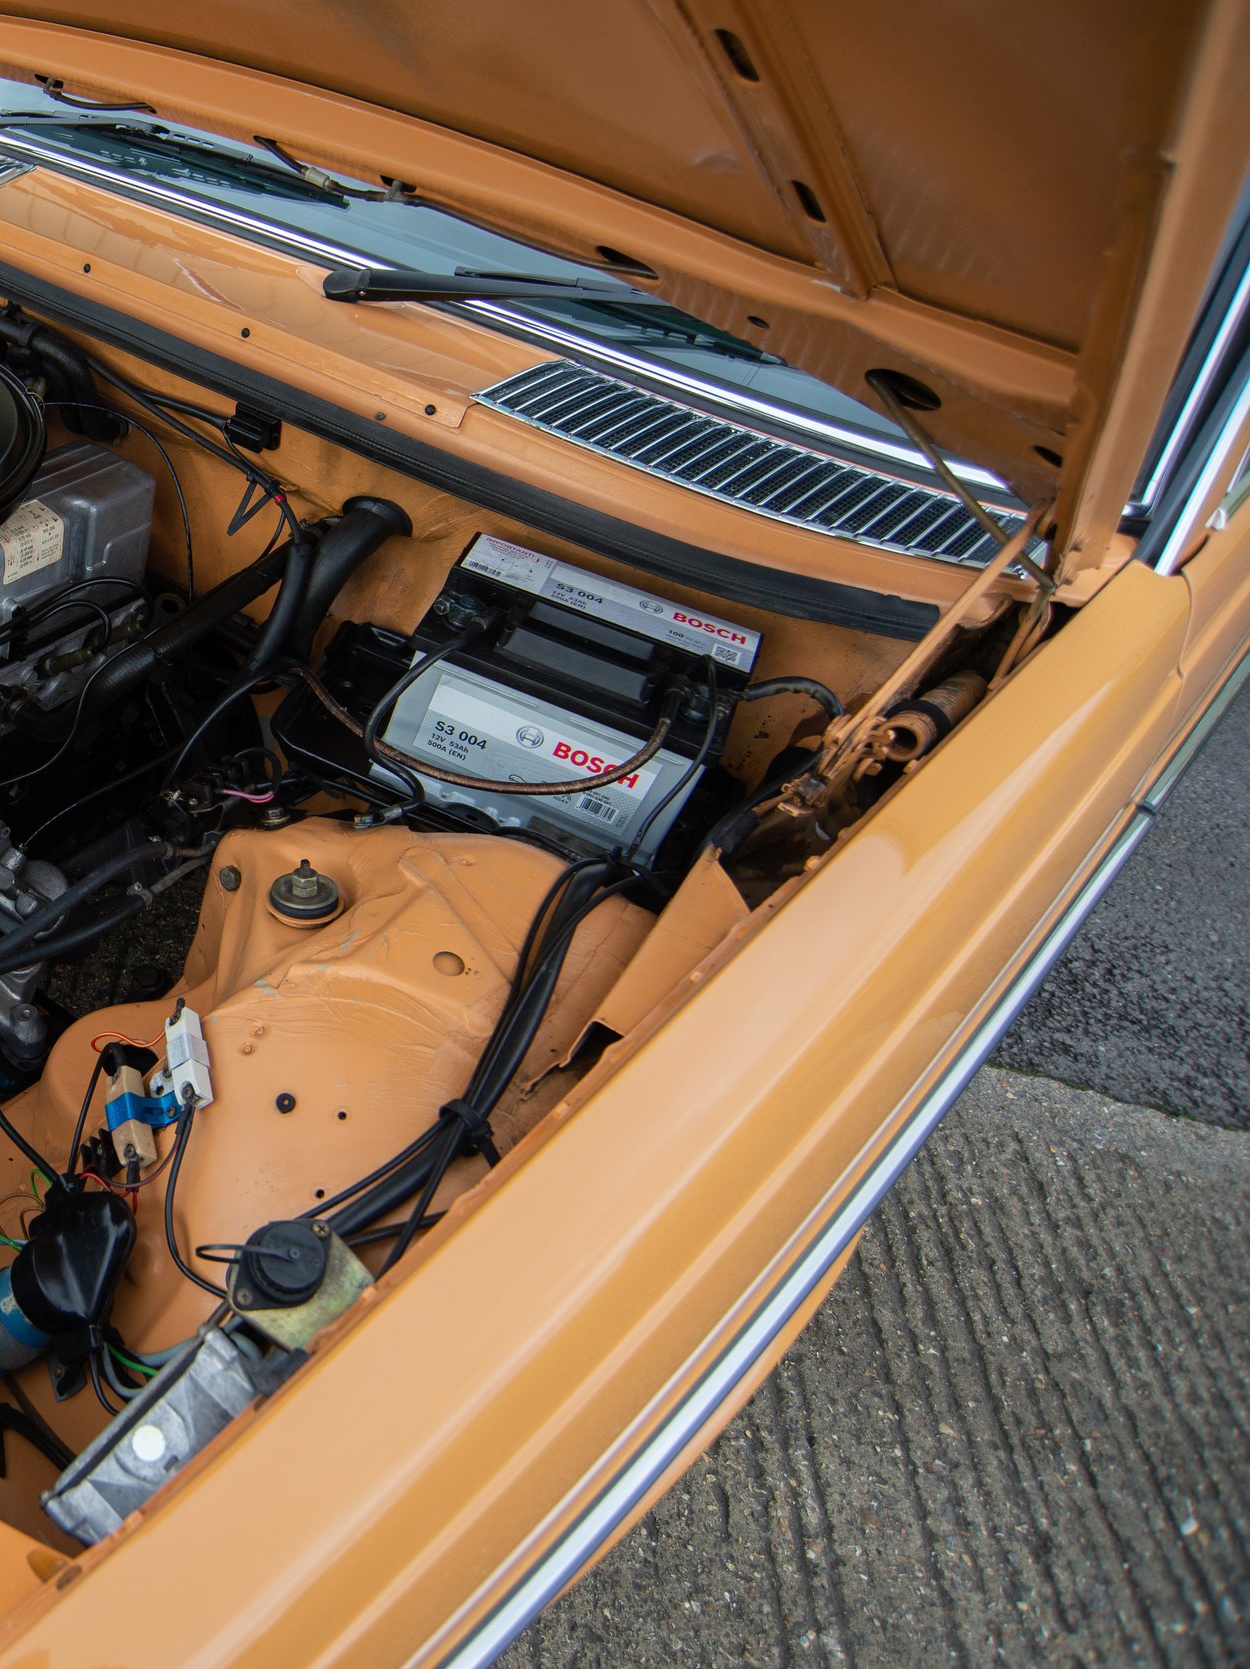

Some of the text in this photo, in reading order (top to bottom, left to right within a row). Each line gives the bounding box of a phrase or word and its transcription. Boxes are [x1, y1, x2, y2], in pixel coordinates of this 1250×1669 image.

[556, 583, 603, 604] S3 004
[672, 611, 747, 645] BOSCH
[431, 733, 469, 754] 12V 53Ah
[435, 721, 488, 750] S3 004
[427, 740, 466, 761] 500A (EN)
